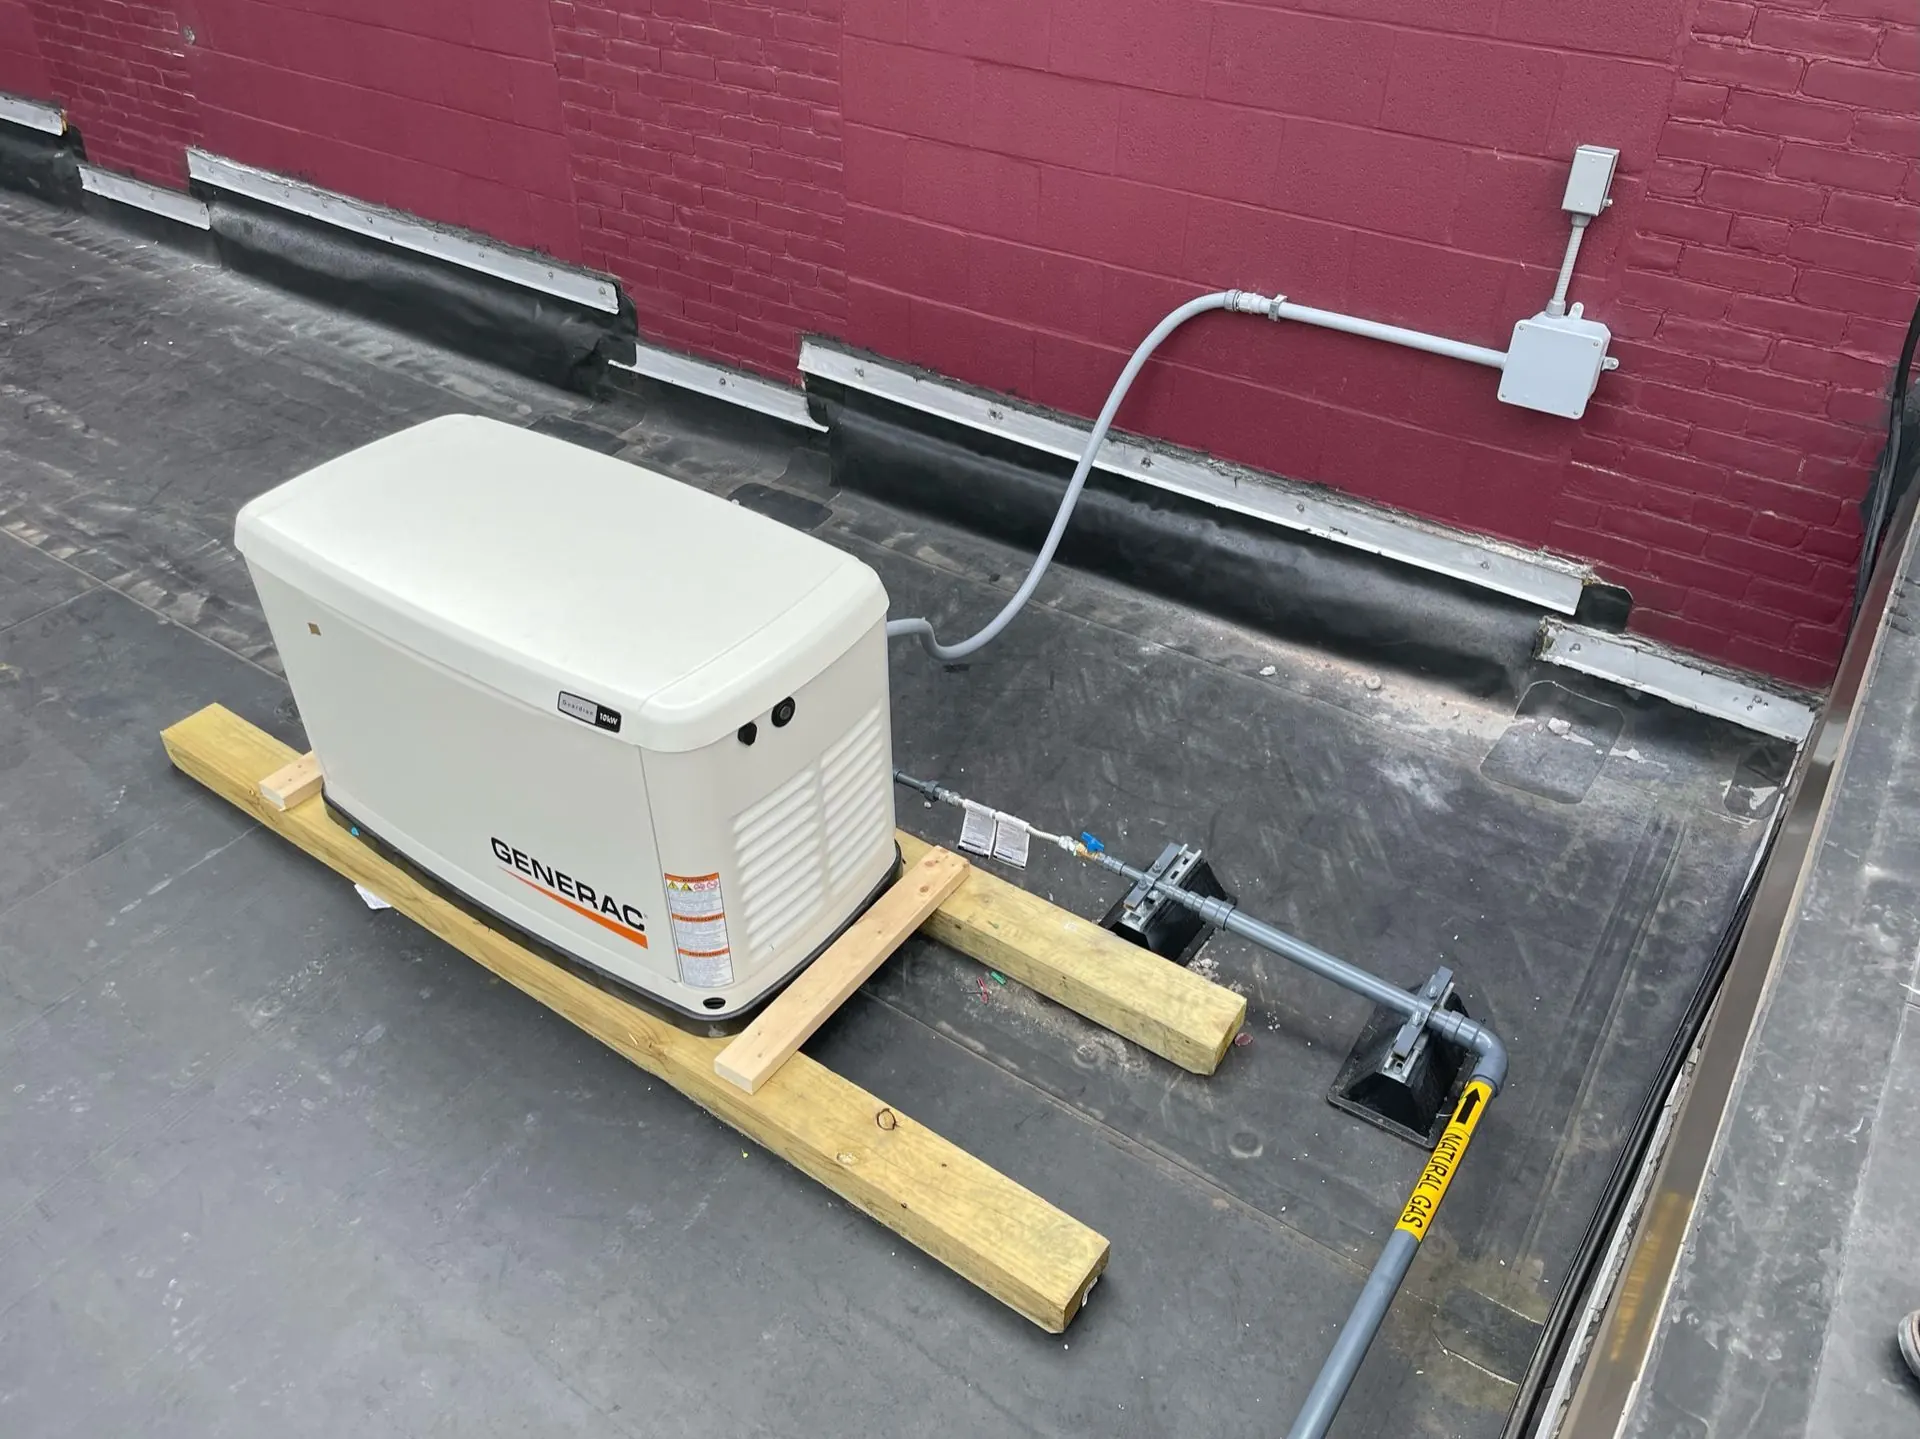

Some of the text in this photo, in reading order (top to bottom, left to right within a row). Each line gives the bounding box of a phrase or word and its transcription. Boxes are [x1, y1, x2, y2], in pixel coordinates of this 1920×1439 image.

[600, 713, 618, 725] 10kW
[491, 837, 645, 931] GENERAC
[1402, 1132, 1463, 1228] NATURAL GAS
